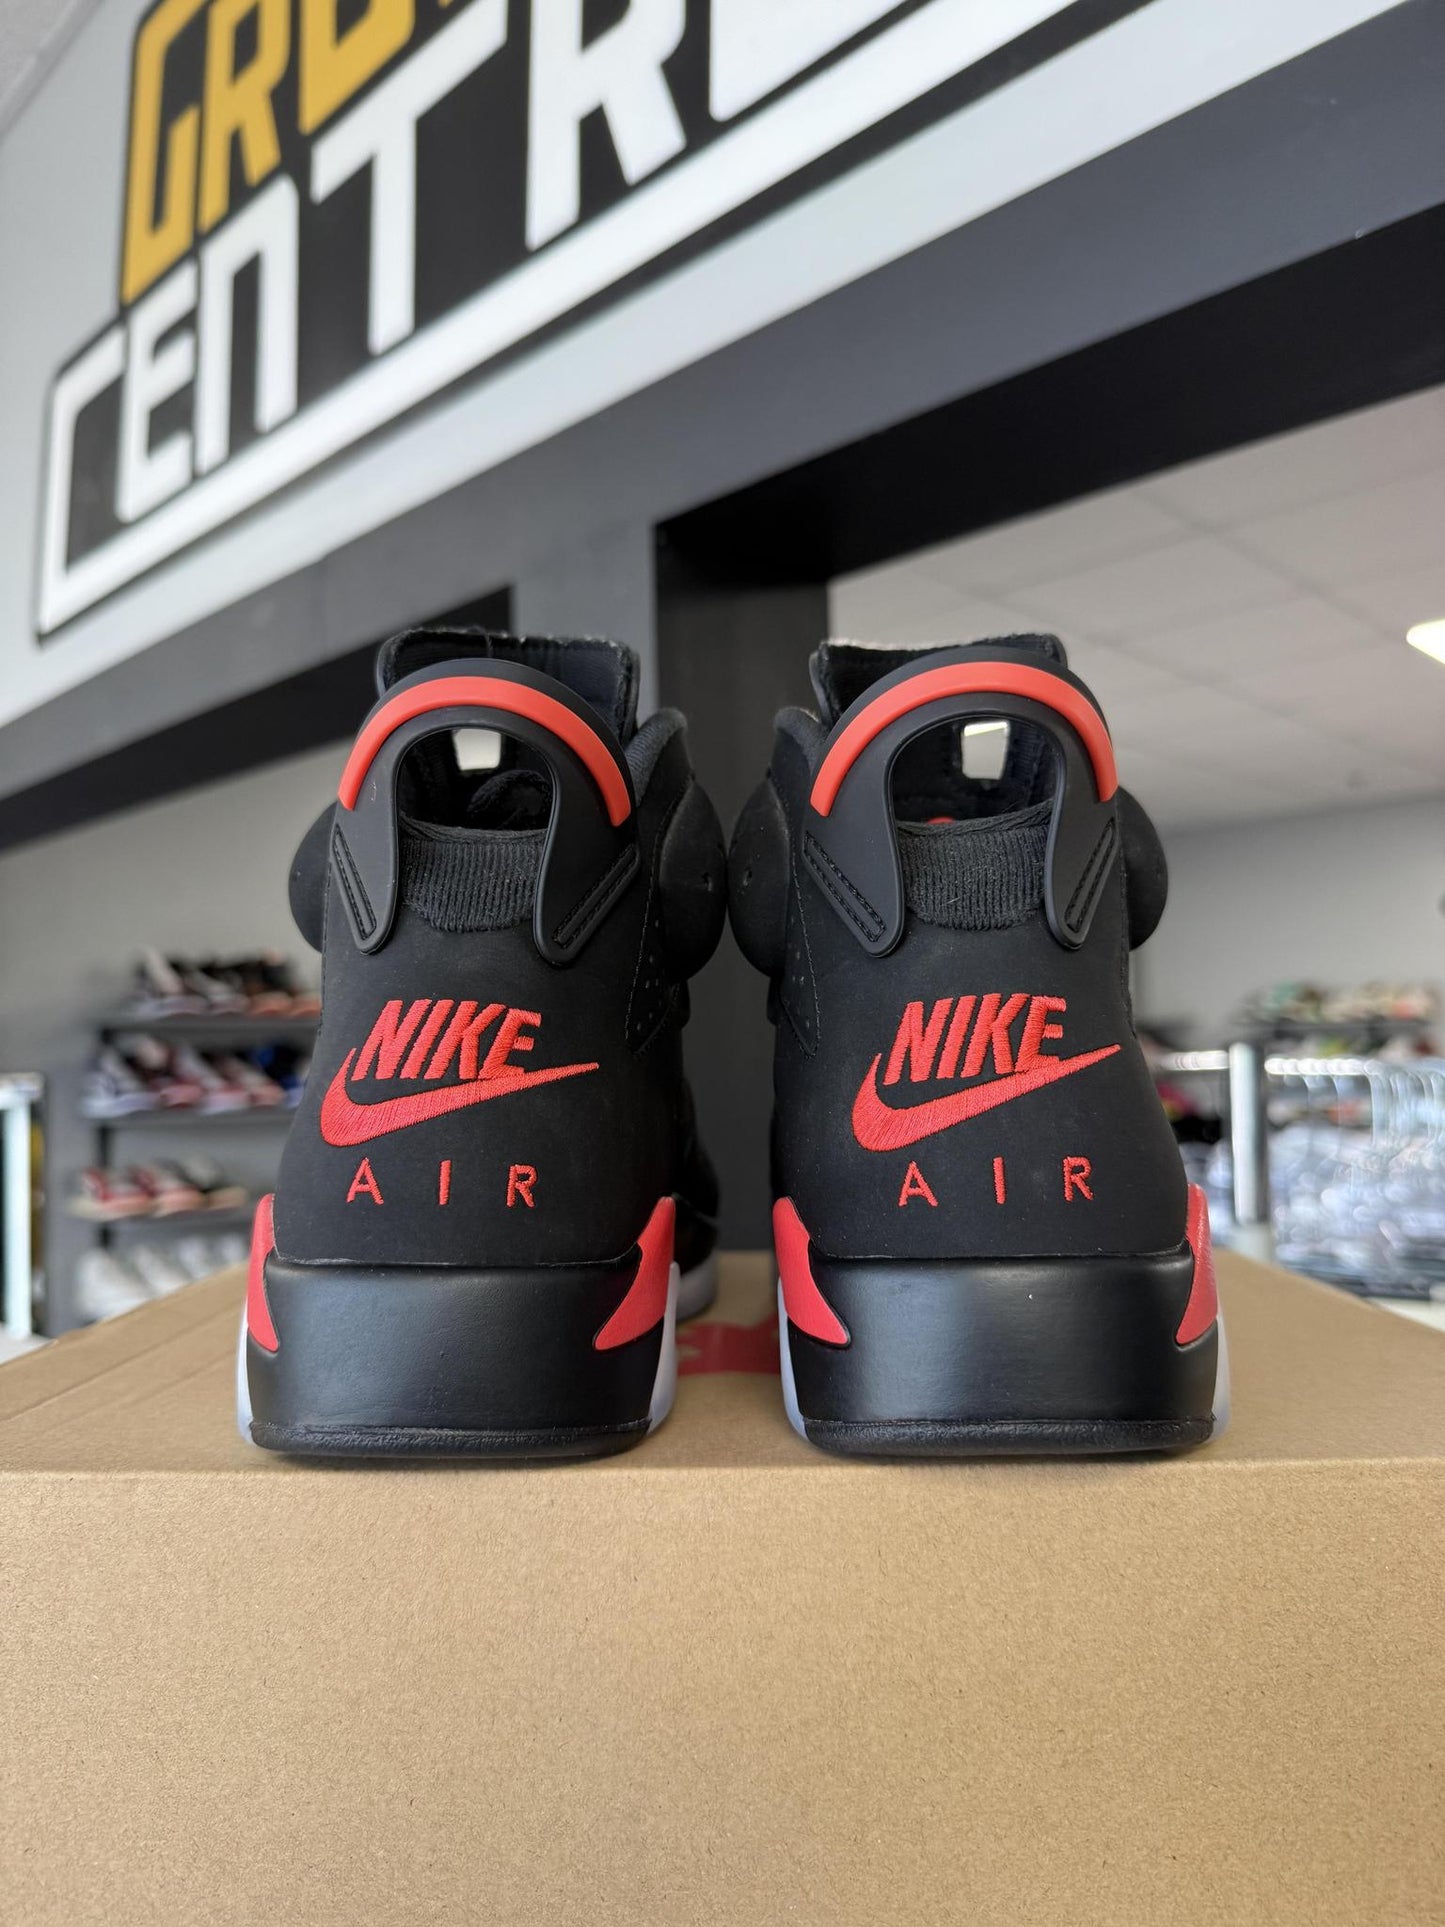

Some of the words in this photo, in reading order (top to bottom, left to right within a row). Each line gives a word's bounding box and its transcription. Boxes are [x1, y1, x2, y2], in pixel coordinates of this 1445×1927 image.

[350, 999, 542, 1082] NIKE
[882, 993, 1067, 1086] NIKE
[346, 1157, 539, 1208] AIR
[898, 1156, 1094, 1207] AIR
